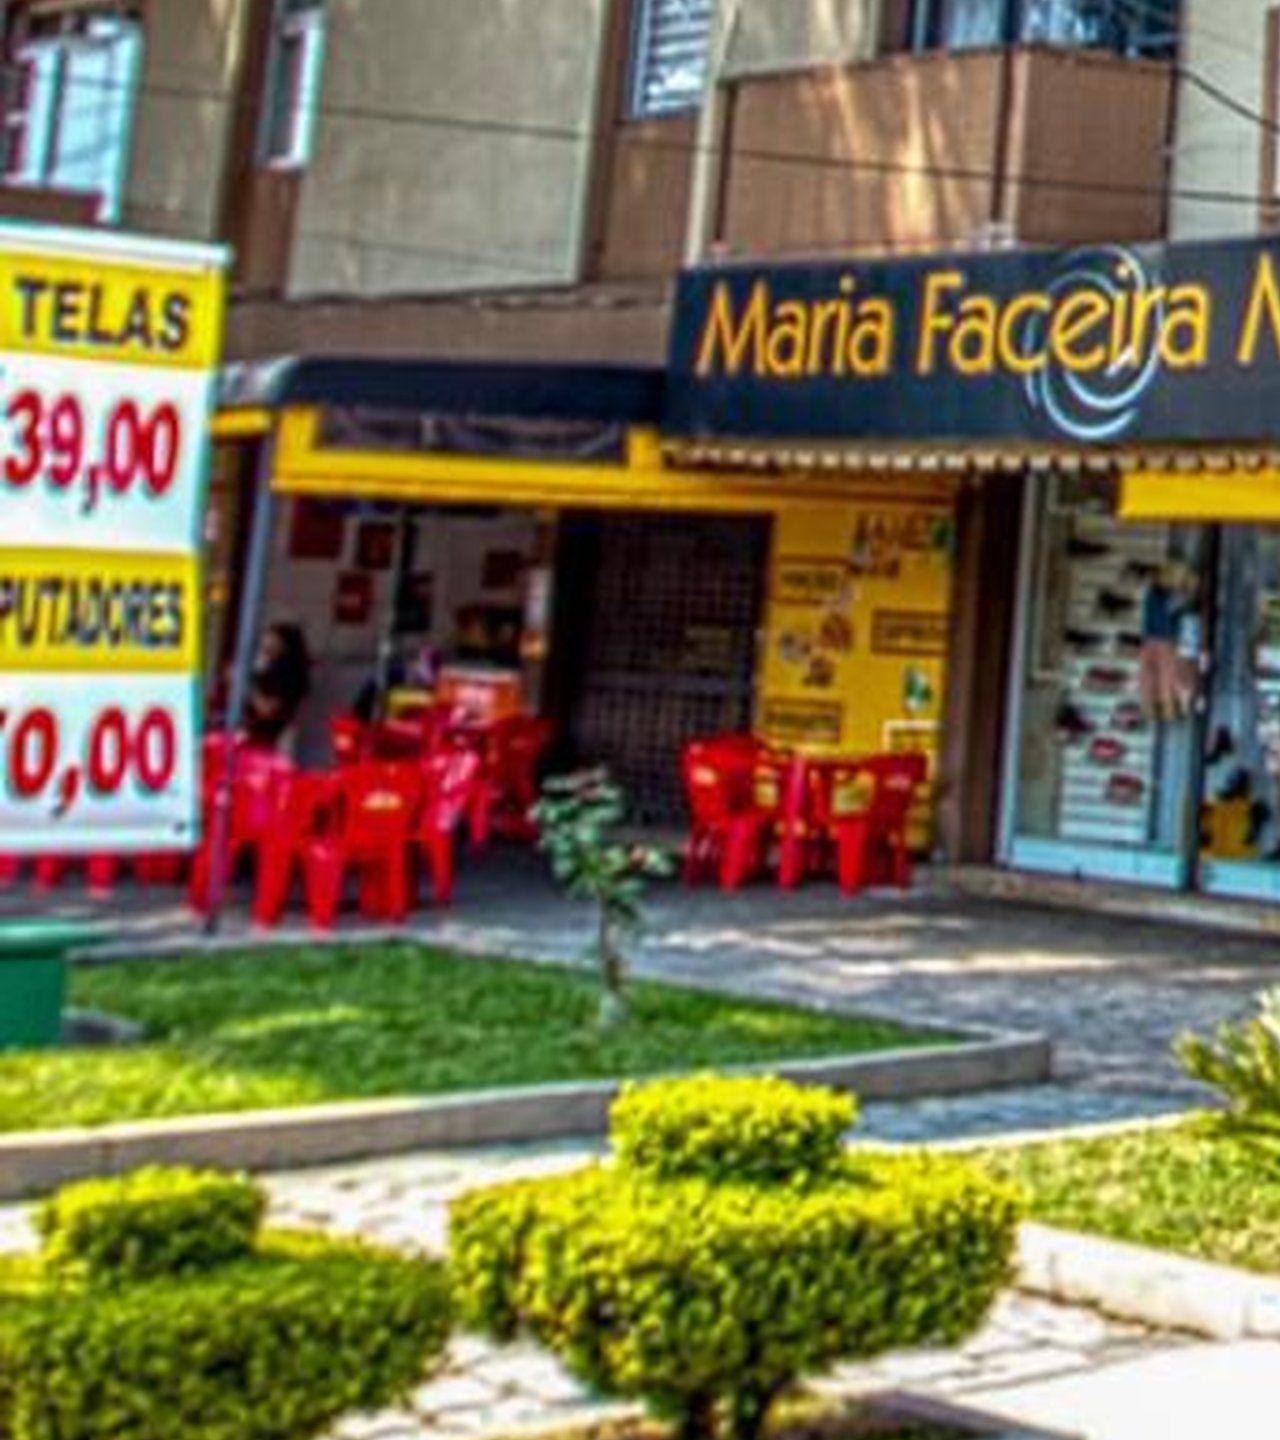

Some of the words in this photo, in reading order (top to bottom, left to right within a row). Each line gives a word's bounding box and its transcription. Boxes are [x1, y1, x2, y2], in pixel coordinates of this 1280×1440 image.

[14, 276, 192, 351] TELAS
[697, 274, 893, 376] Maria
[916, 262, 1212, 378] Faceira
[2, 387, 181, 514] 39,00
[0, 704, 176, 818] 0,00
